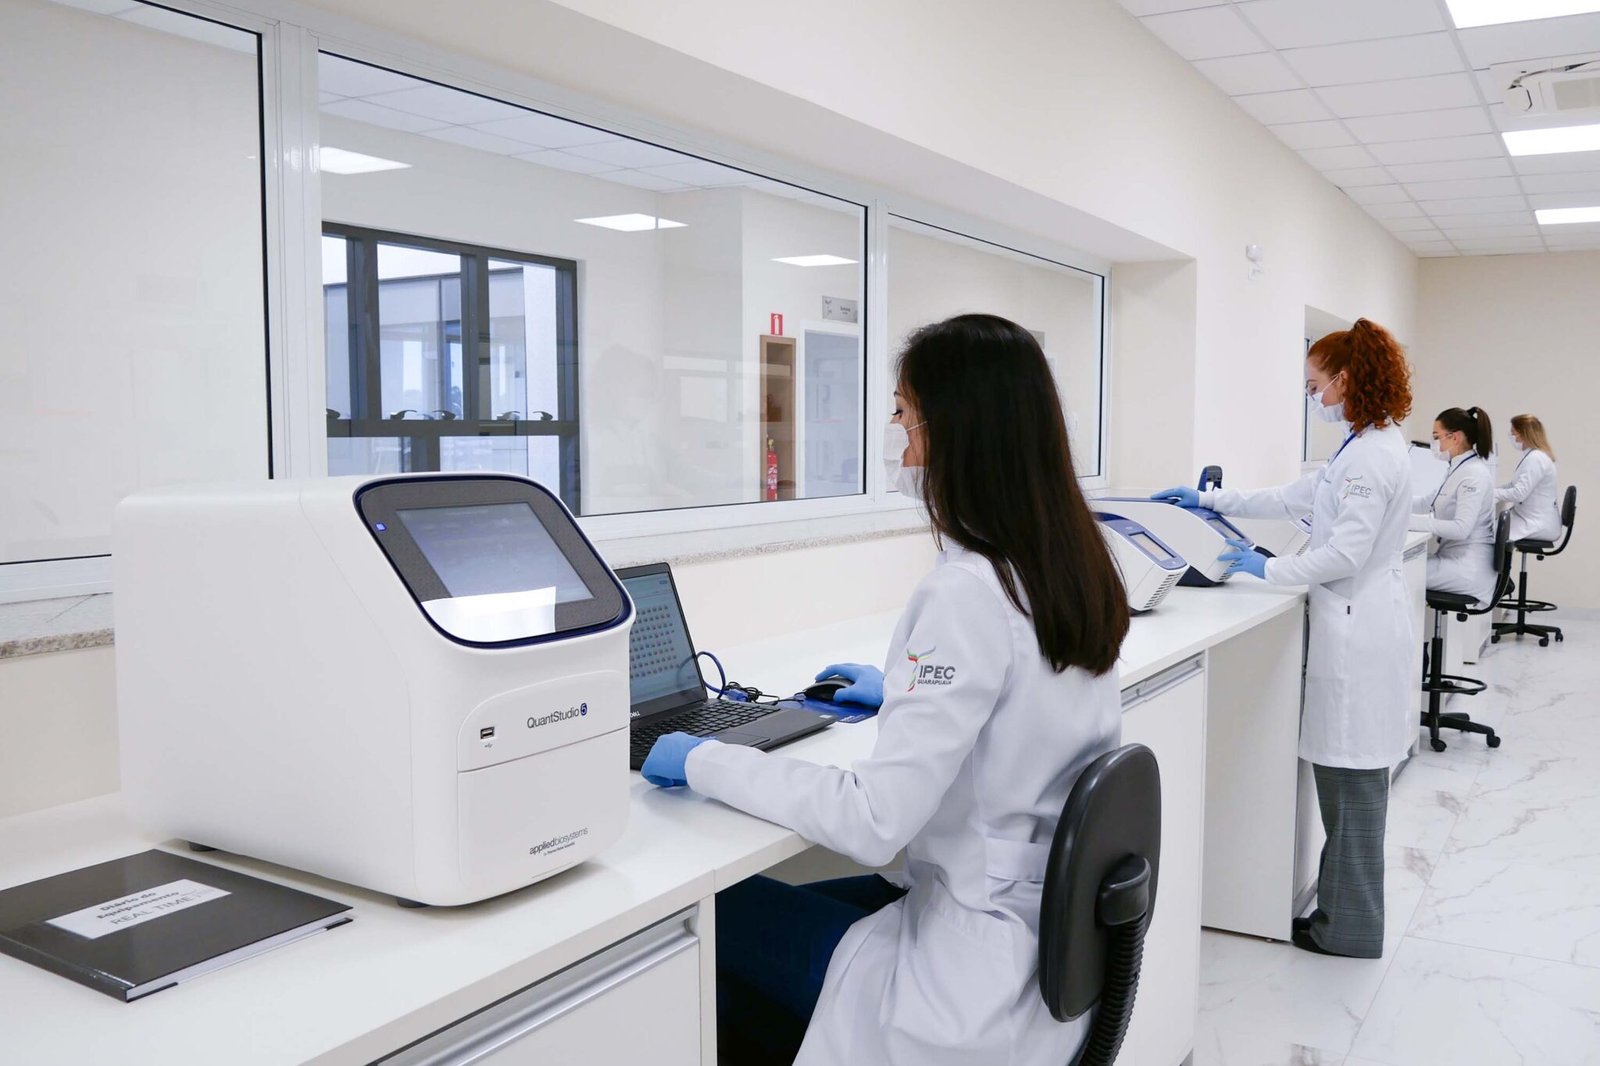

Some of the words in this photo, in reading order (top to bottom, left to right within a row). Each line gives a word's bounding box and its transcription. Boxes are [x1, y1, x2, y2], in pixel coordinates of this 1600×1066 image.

[1351, 484, 1371, 495] IPEC
[919, 665, 956, 680] IPEC
[526, 706, 580, 729] QuantStudio
[96, 892, 181, 919] Equipamento
[110, 910, 153, 925] REAL
[154, 896, 194, 911] TIME
